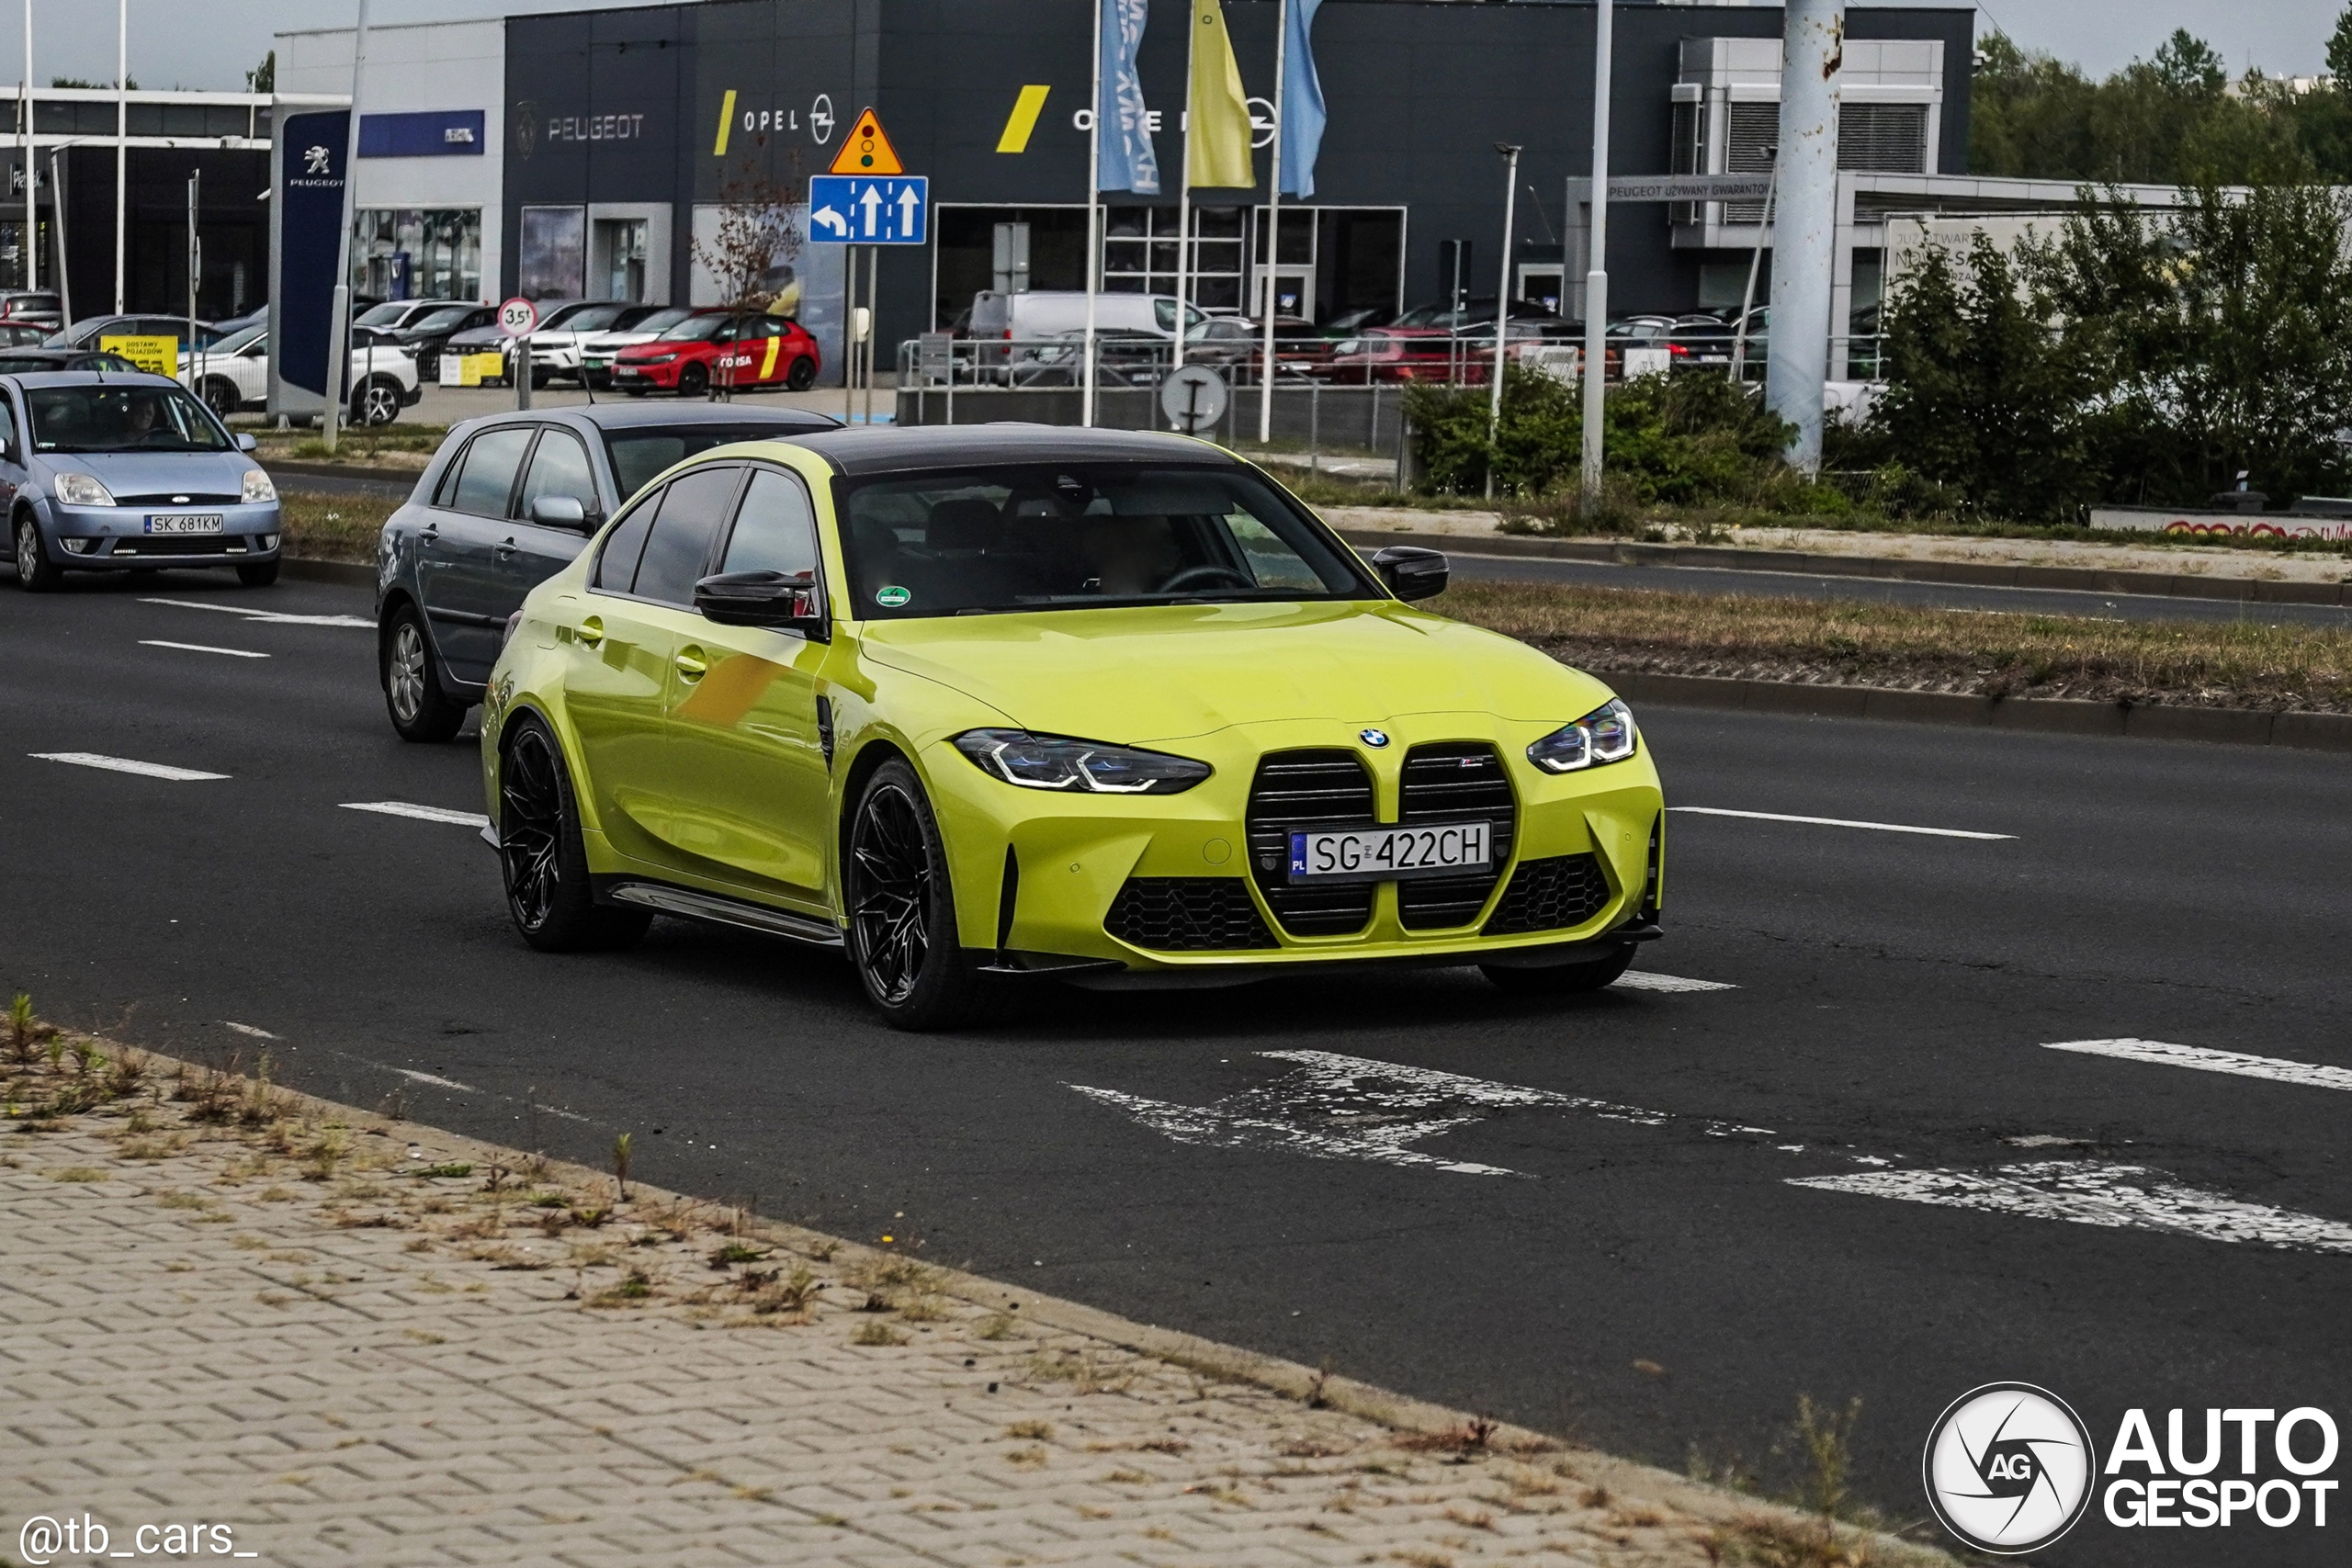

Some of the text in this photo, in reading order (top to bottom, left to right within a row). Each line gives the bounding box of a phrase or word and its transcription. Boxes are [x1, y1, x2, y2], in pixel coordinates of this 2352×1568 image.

[548, 114, 644, 141] PEUGEOT
[744, 109, 798, 131] OPEL
[289, 178, 345, 187] PEUGEOT
[1610, 186, 1663, 197] PEUGEOT
[1665, 183, 1709, 197] UŻYWANY
[504, 308, 531, 327] 3,5t
[154, 517, 220, 531] SK 681KM
[1292, 828, 1481, 872] PL SG 422CH
